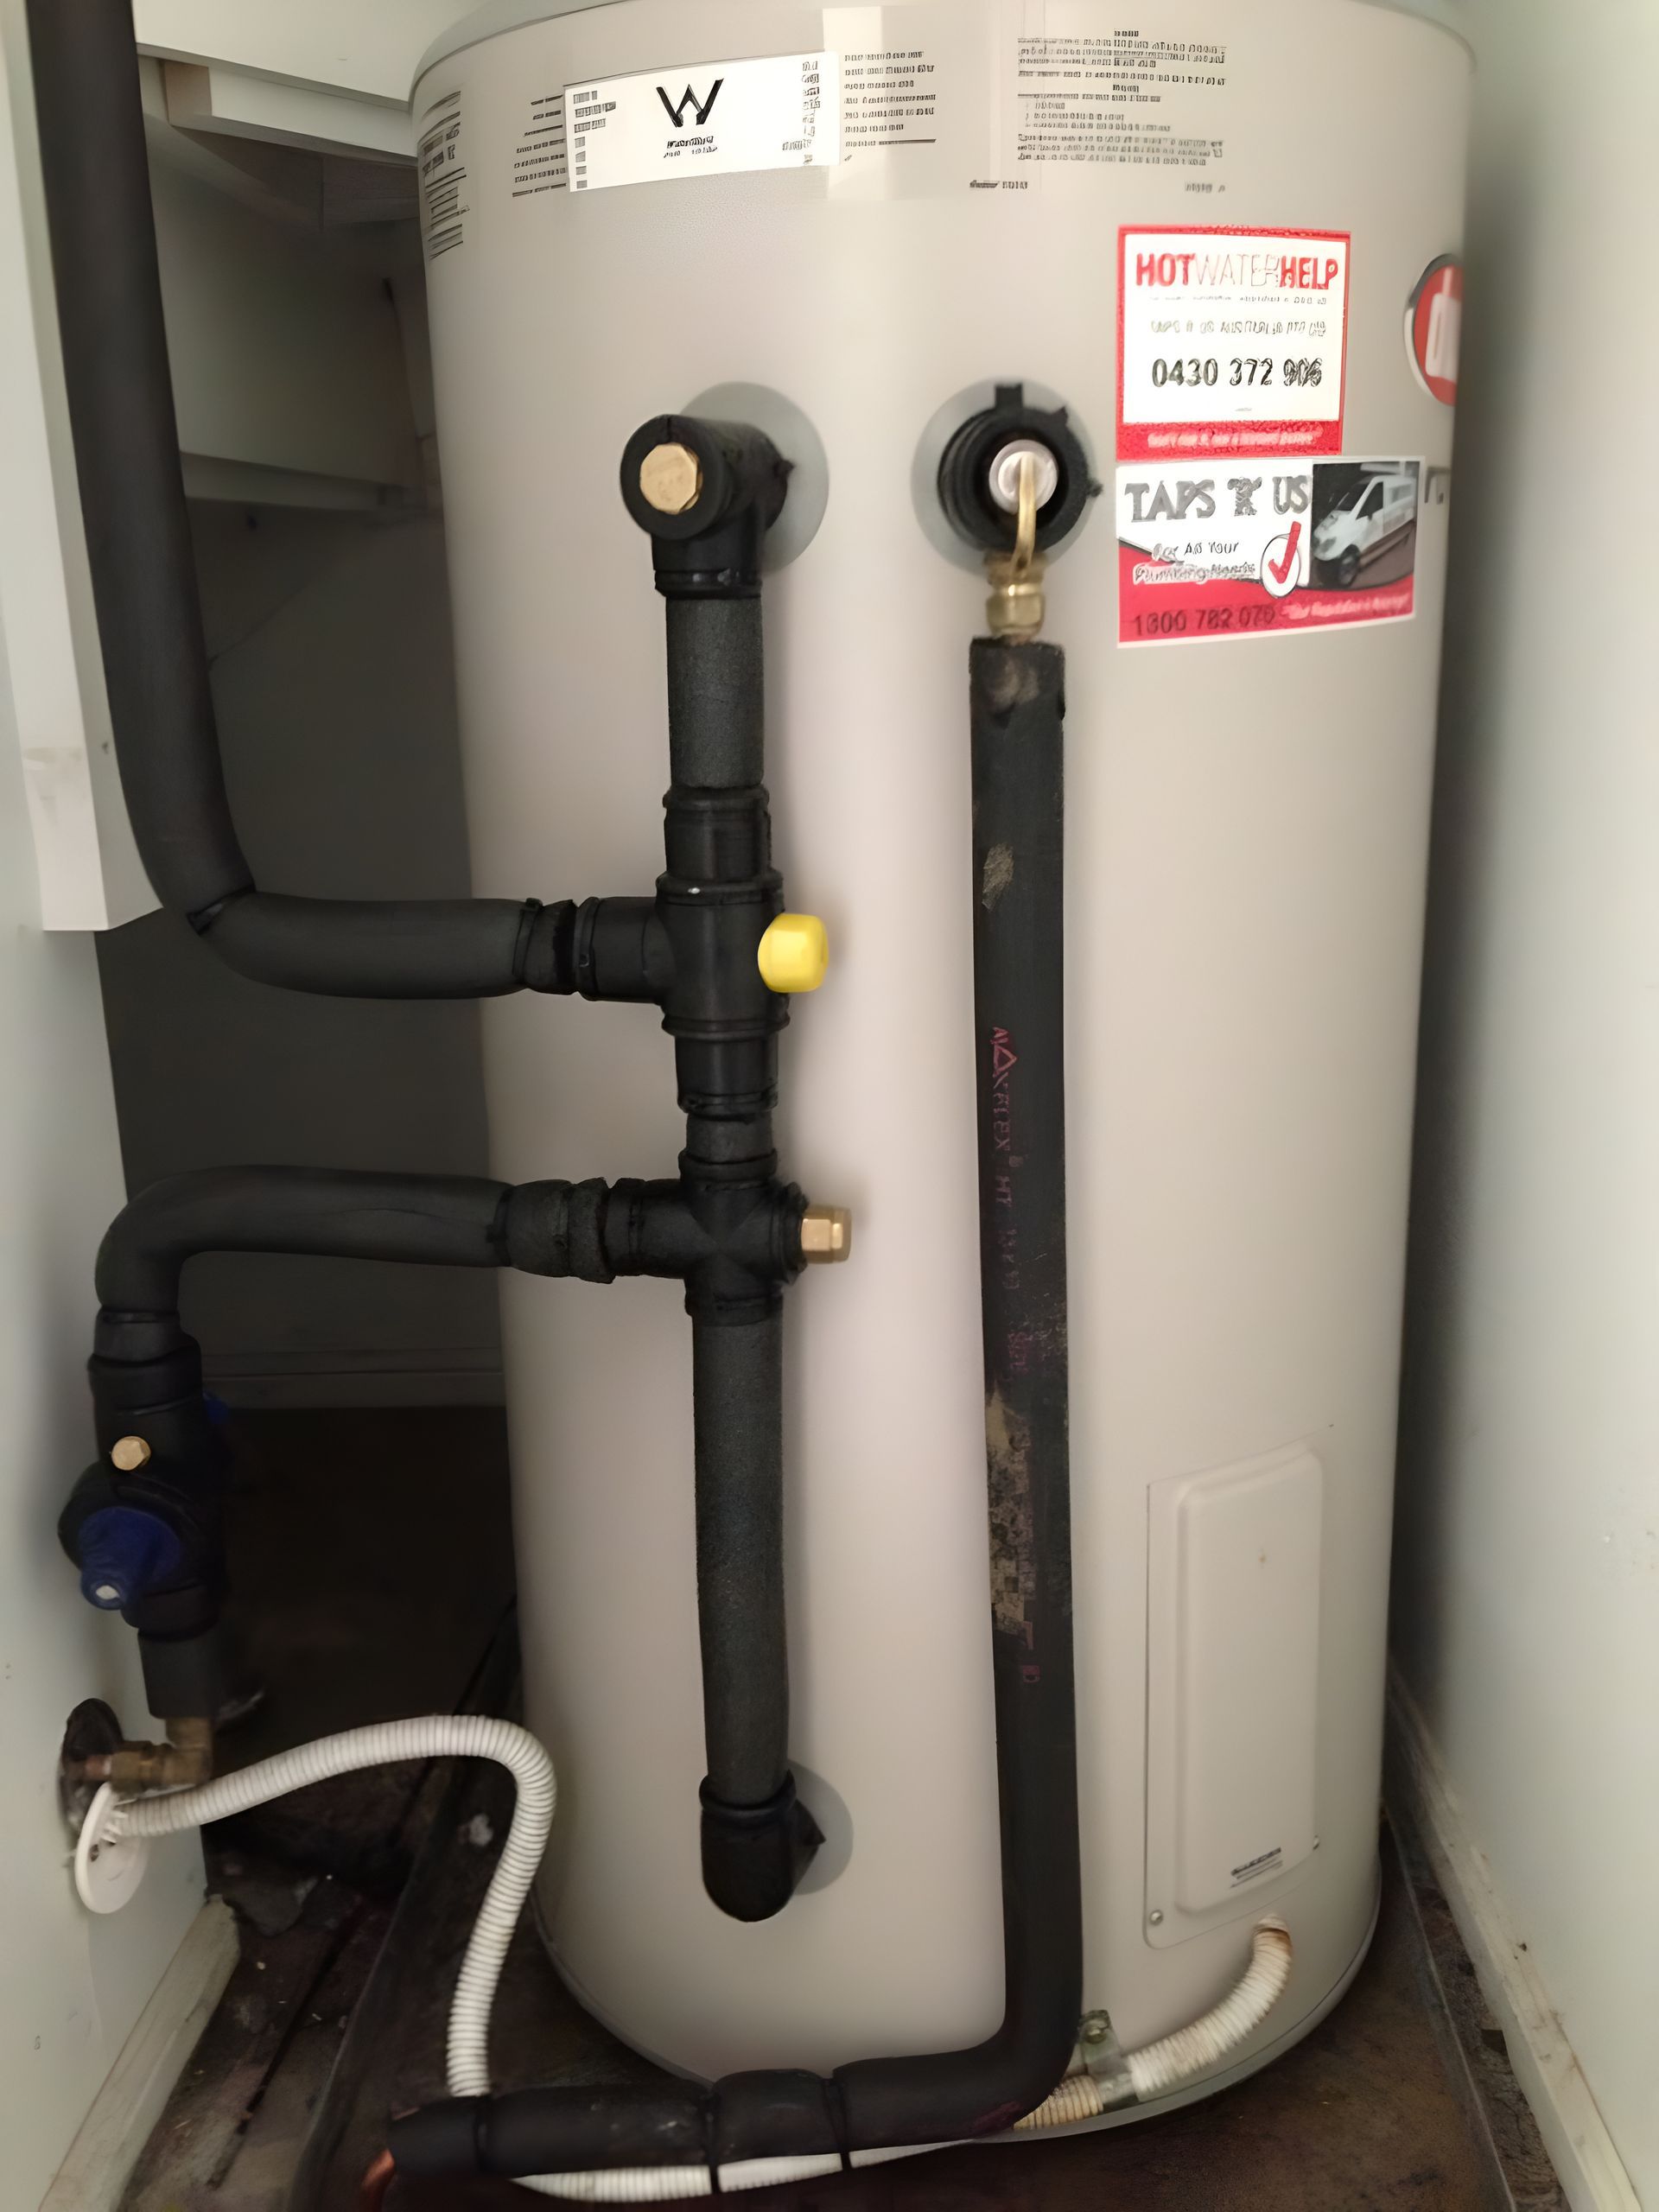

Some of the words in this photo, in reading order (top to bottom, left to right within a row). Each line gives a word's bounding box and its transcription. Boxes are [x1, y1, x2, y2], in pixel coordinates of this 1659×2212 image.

[1152, 357, 1218, 388] 0430
[1230, 357, 1273, 387] 372
[1124, 480, 1216, 523] TAPS
[1272, 474, 1311, 515] US
